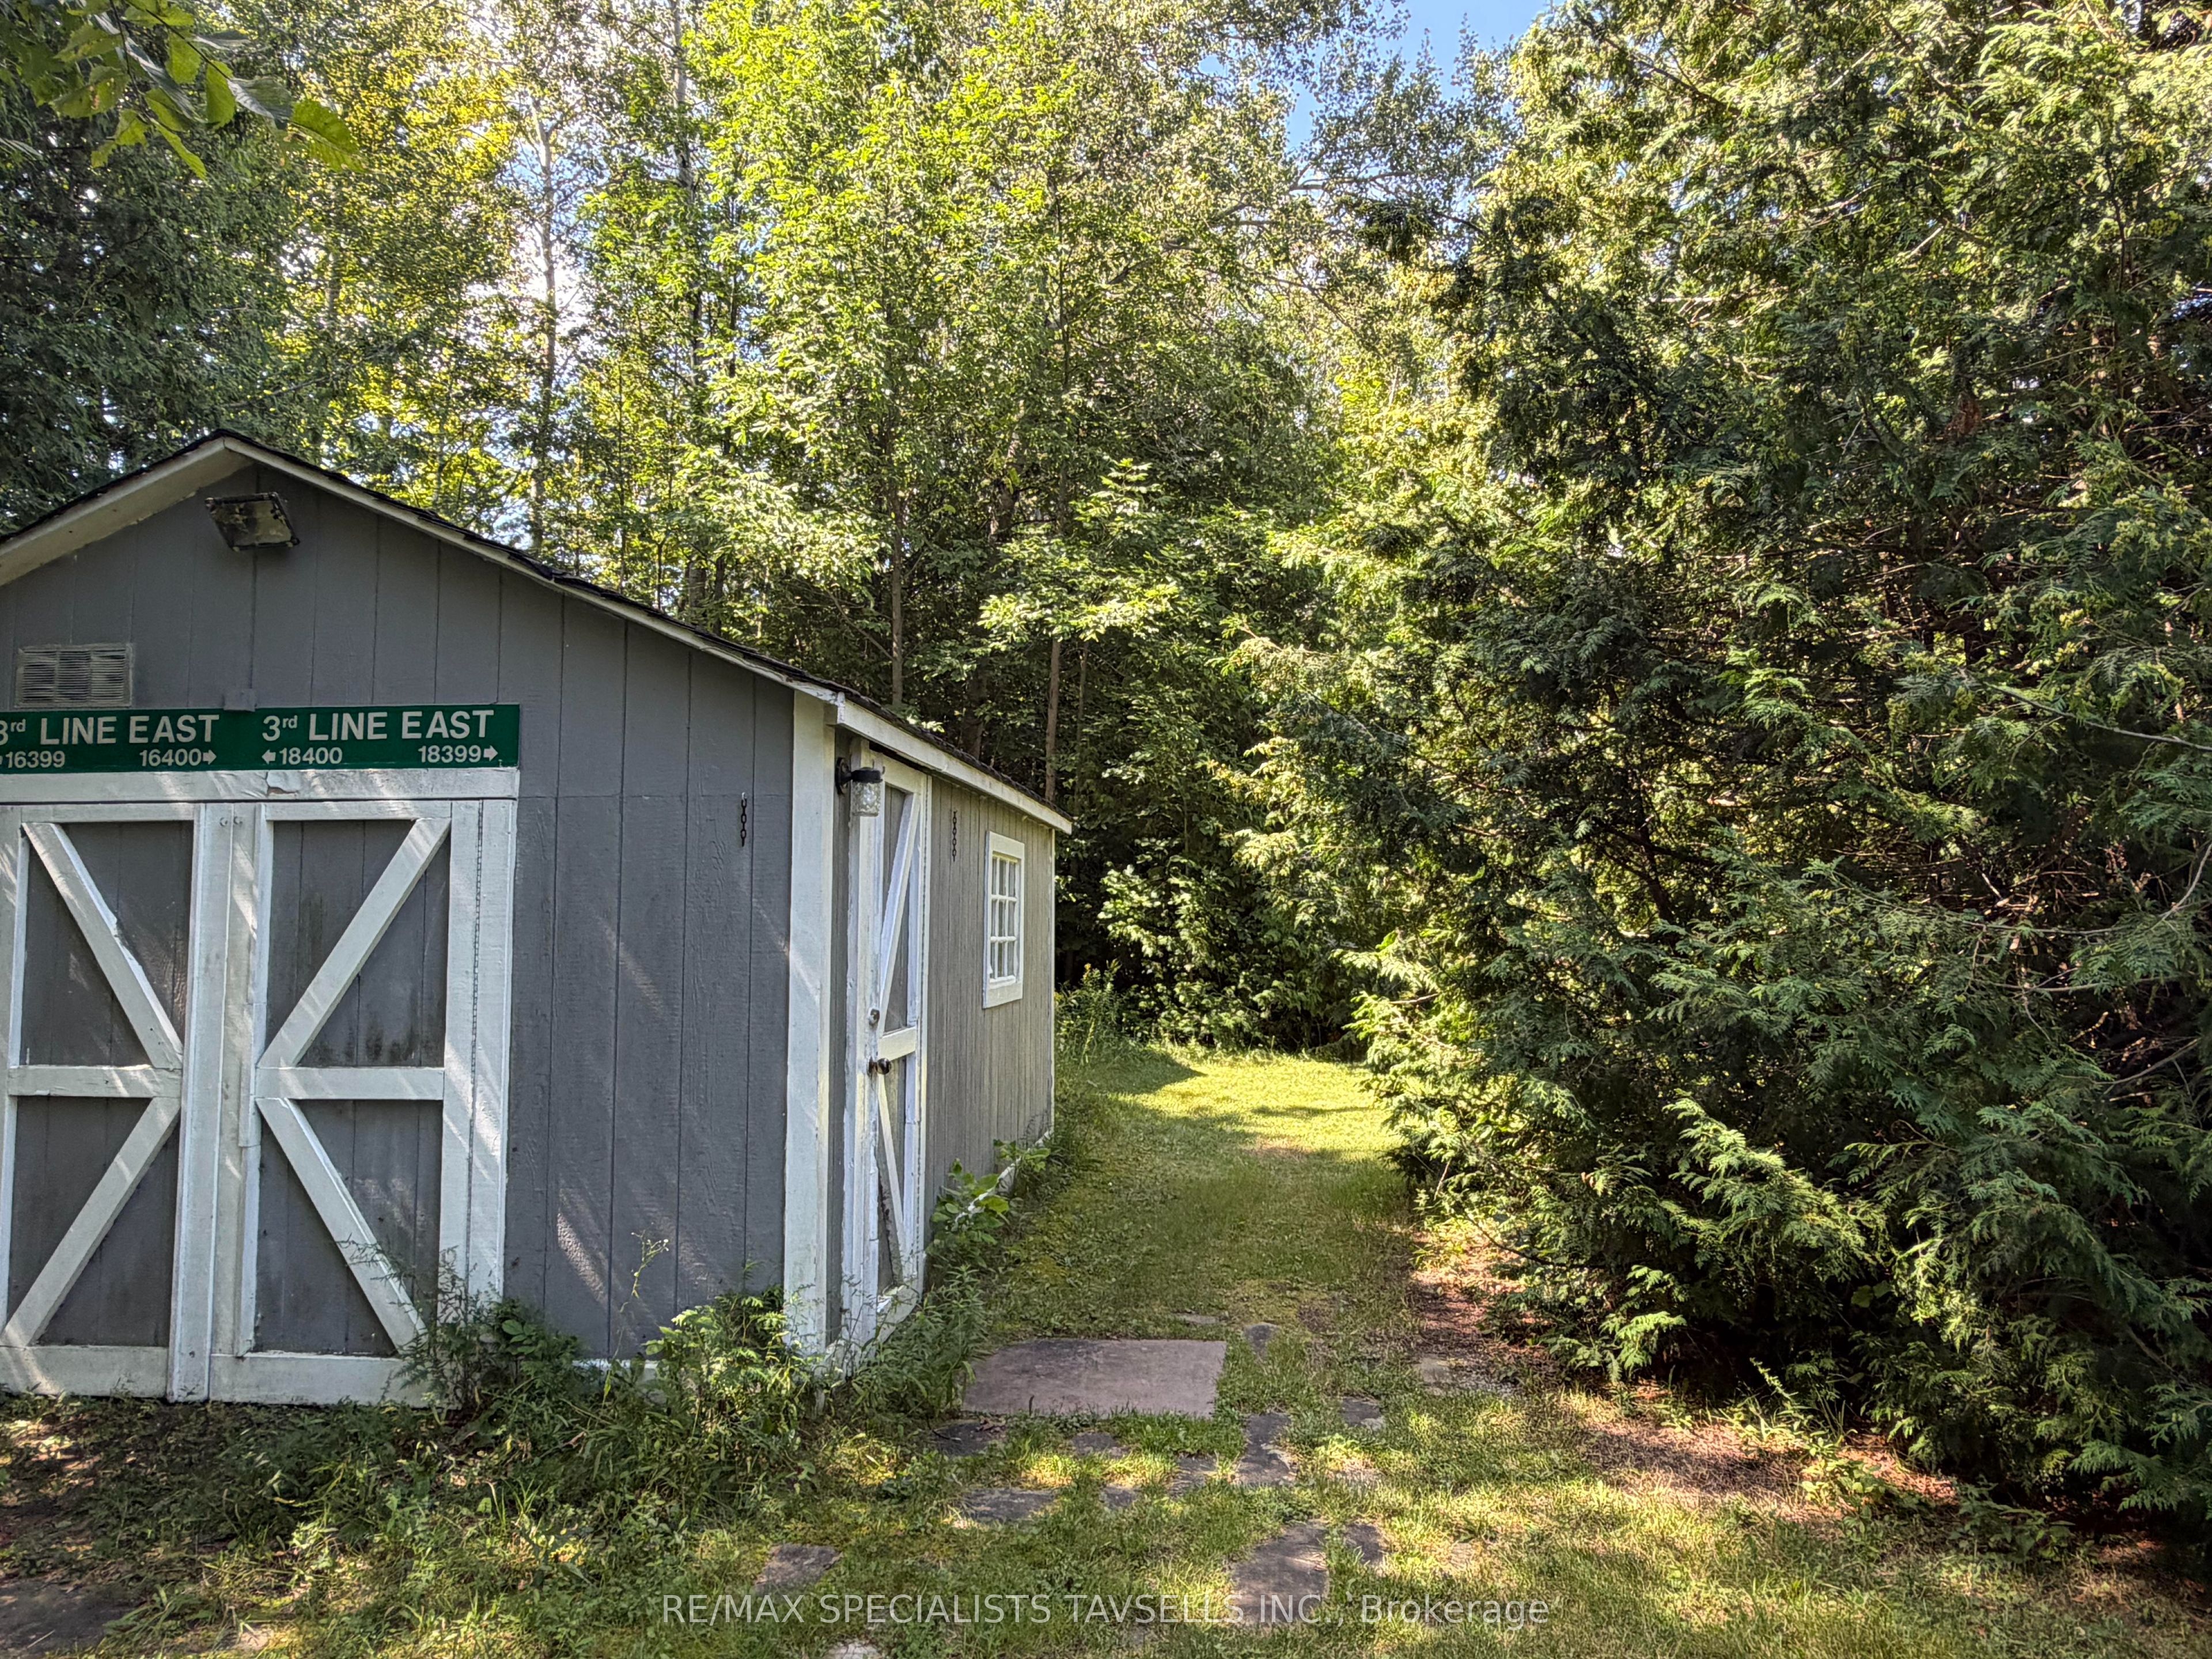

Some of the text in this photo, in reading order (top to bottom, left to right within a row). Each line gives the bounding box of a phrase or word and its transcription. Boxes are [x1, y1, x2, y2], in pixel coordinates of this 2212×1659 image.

[40, 716, 118, 745] LINE
[128, 714, 219, 744] EAST
[262, 710, 494, 741] 3rd LINE EAST
[6, 751, 66, 768] 16399
[139, 748, 202, 767] 16400
[279, 747, 343, 765] 18400
[418, 745, 482, 763] 18399
